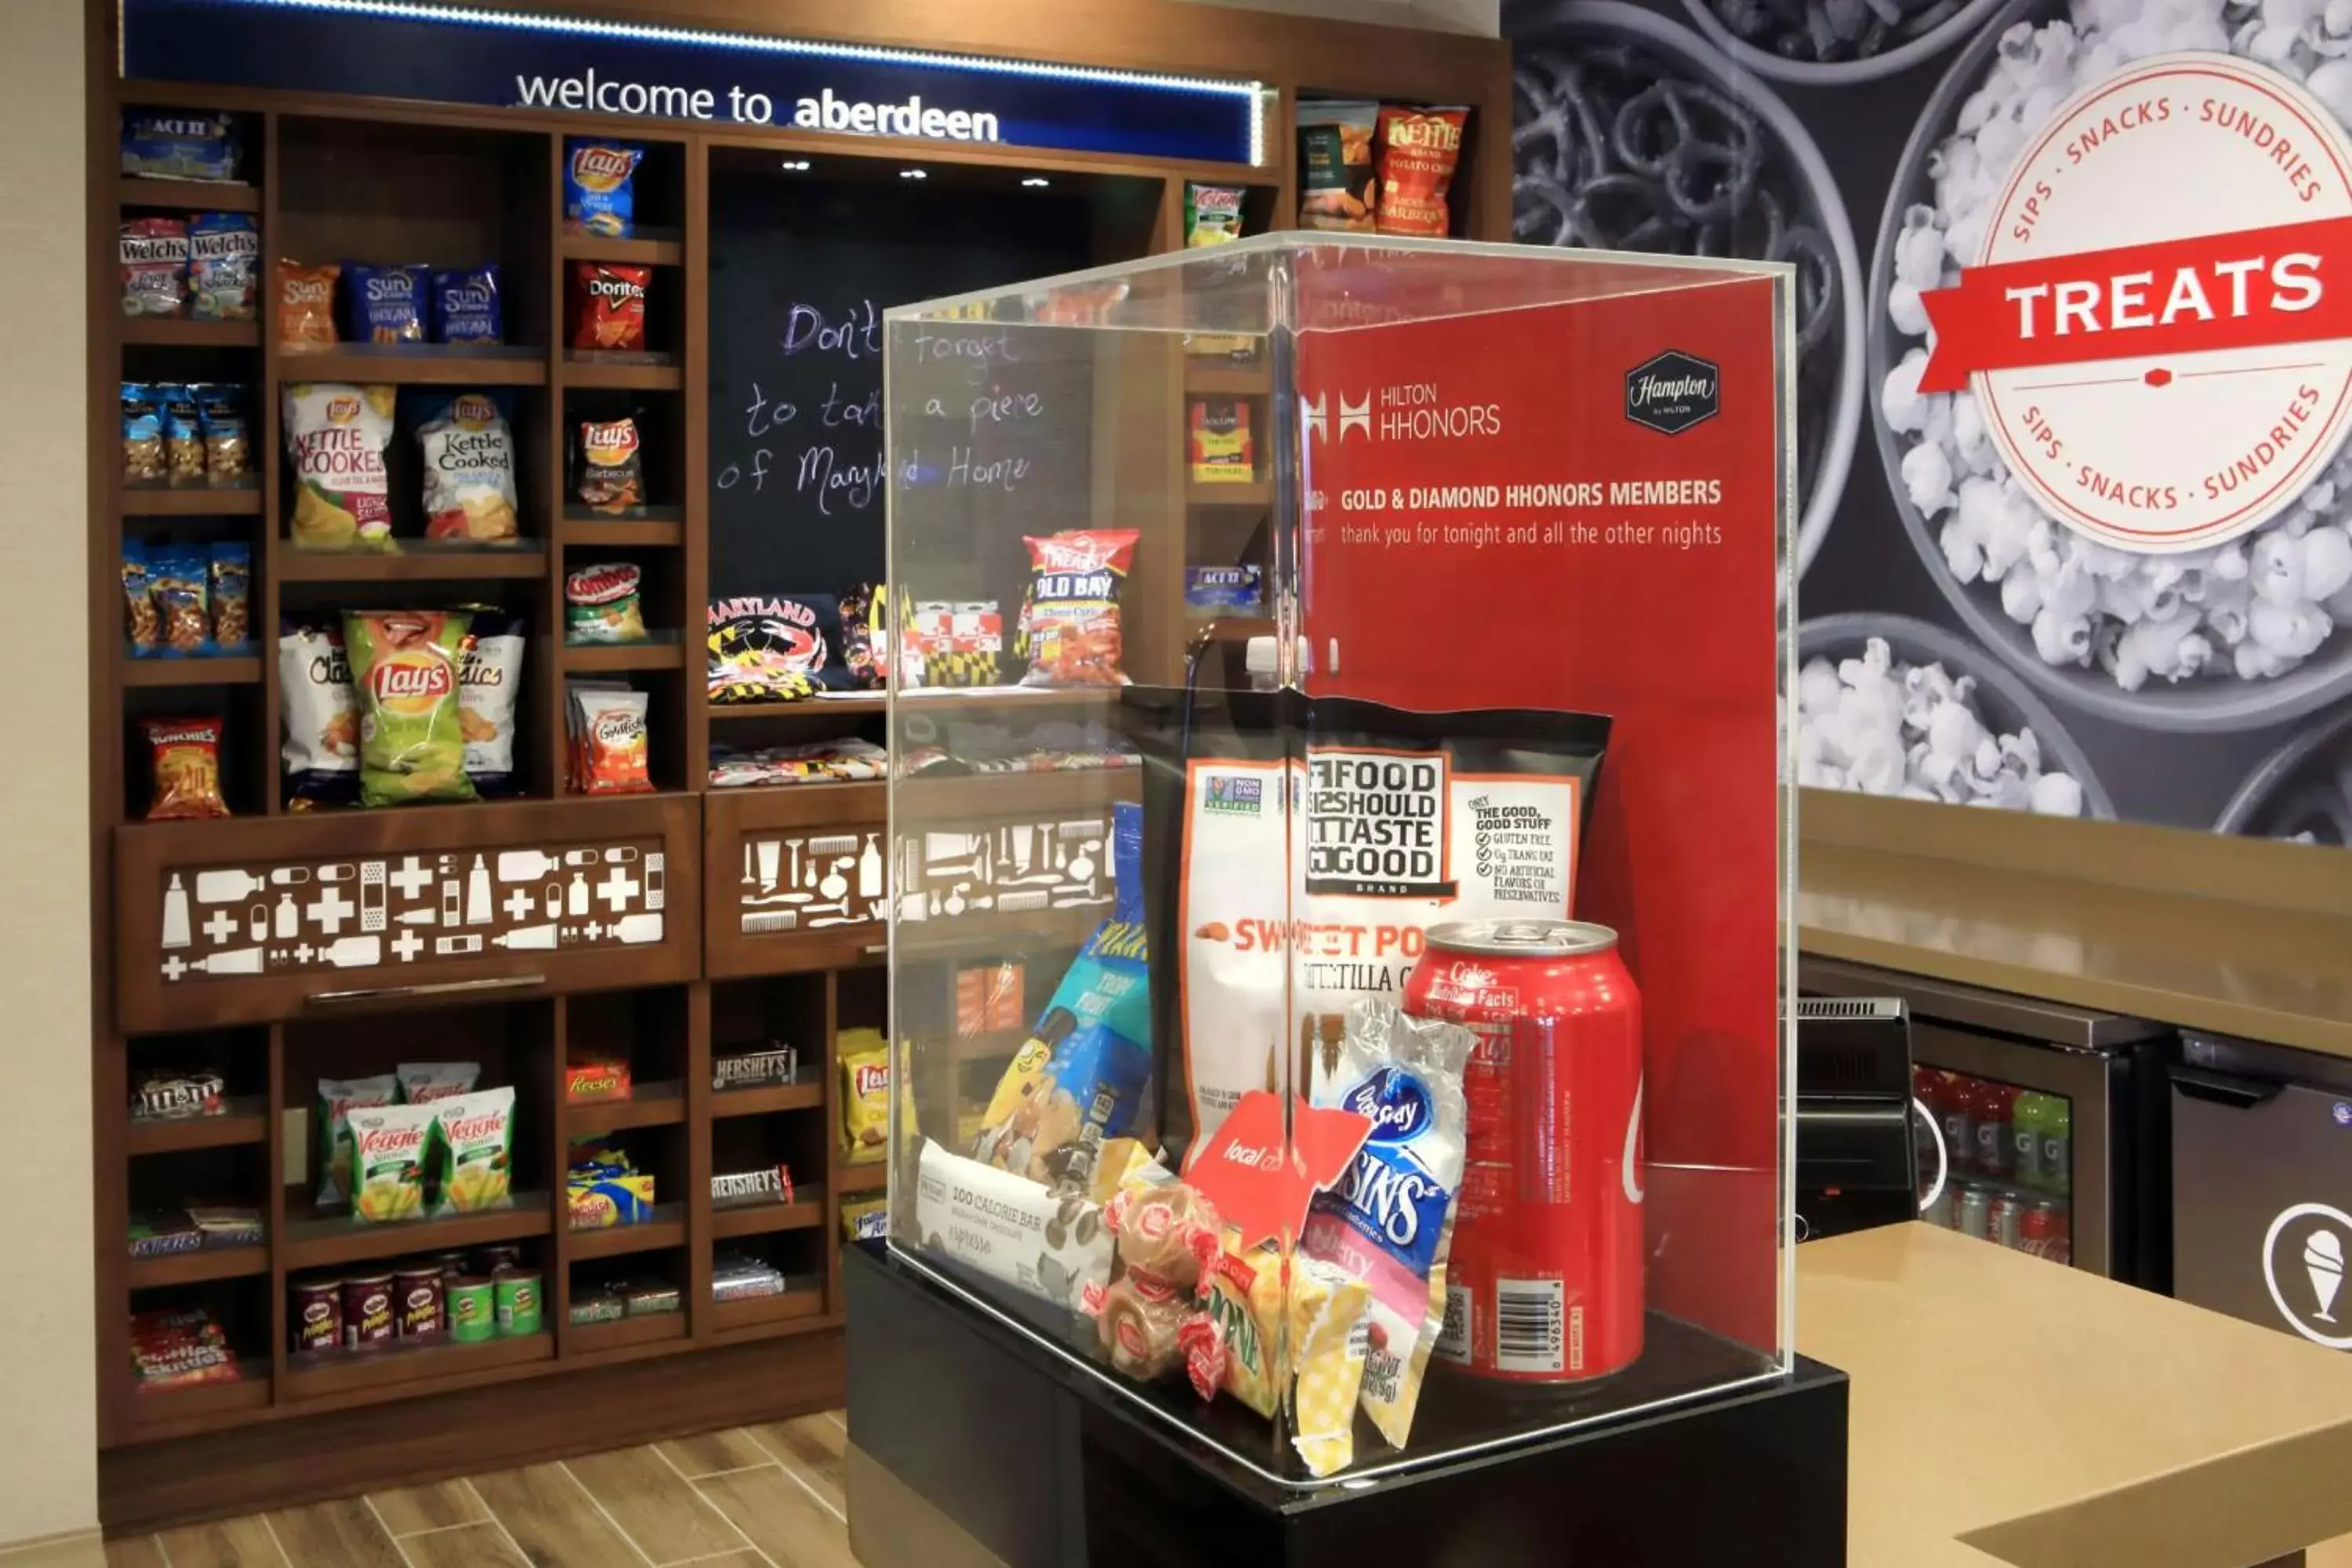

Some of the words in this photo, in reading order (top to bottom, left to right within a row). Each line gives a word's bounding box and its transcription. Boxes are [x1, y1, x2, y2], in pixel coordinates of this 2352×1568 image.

[516, 68, 714, 120] welcome
[728, 85, 772, 124] to
[794, 88, 998, 142] aberdeen
[2014, 180, 2052, 243] SIPS
[2066, 97, 2170, 165] SNACKS
[2198, 98, 2321, 204] SUNDRIES
[2005, 252, 2323, 339] TREATS
[782, 299, 883, 360] Don't
[1381, 383, 1437, 406] HILTON
[1631, 372, 1715, 406] Hampton
[747, 383, 797, 437] to
[821, 382, 884, 430] tak
[926, 397, 945, 416] a
[1381, 405, 1501, 441] HHONORS
[1663, 405, 1691, 415] HILTON
[296, 428, 365, 457] KETTLE
[444, 433, 503, 455] Kettle
[2022, 405, 2063, 460] SIPS
[2076, 464, 2177, 510] SNACKS
[2204, 384, 2321, 500] SUNDRIES
[438, 451, 510, 471] Cooked
[717, 449, 774, 493] of
[949, 447, 1032, 492] Home
[1341, 489, 1386, 510] GOLD
[1392, 488, 1404, 509] &
[1410, 485, 1500, 510] DIAMOND
[1506, 483, 1603, 507] HHONORS
[1609, 479, 1722, 506] MEMBERS
[1341, 522, 1380, 543] thank
[1385, 527, 1410, 548] you
[1417, 522, 1439, 543] for
[1443, 521, 1501, 550] tonight
[1506, 521, 1537, 544] and
[1543, 521, 1564, 544] all
[1570, 521, 1599, 544] the
[1605, 521, 1653, 544] other
[1662, 520, 1722, 550] nights
[1075, 575, 1112, 597] BAY
[1335, 760, 1436, 793] FOOD
[1334, 791, 1436, 818] SHOULD
[1476, 807, 1500, 818] THE
[1502, 806, 1541, 819] GOOD,
[1333, 817, 1434, 848] TASTE
[1476, 818, 1511, 830] GOOD
[1514, 818, 1552, 829] STUFF
[1494, 833, 1528, 844] GLUTEN
[1530, 833, 1552, 846] FREE
[1335, 846, 1434, 878] GOOD
[1356, 884, 1408, 894] BRAND
[1494, 876, 1532, 889] FLAVORS
[1494, 888, 1560, 904] PRESERVATIVES
[1375, 926, 1426, 957] PO
[1478, 989, 1515, 1007] Facts
[717, 1054, 786, 1080] HERSHEY'S
[1223, 1138, 1268, 1167] local
[2016, 1133, 2031, 1153] G
[2045, 1140, 2058, 1160] G
[710, 1169, 781, 1199] HERSHEY'S
[952, 1186, 974, 1206] 100
[974, 1191, 1019, 1224] CALORIE
[1020, 1212, 1042, 1232] BAR
